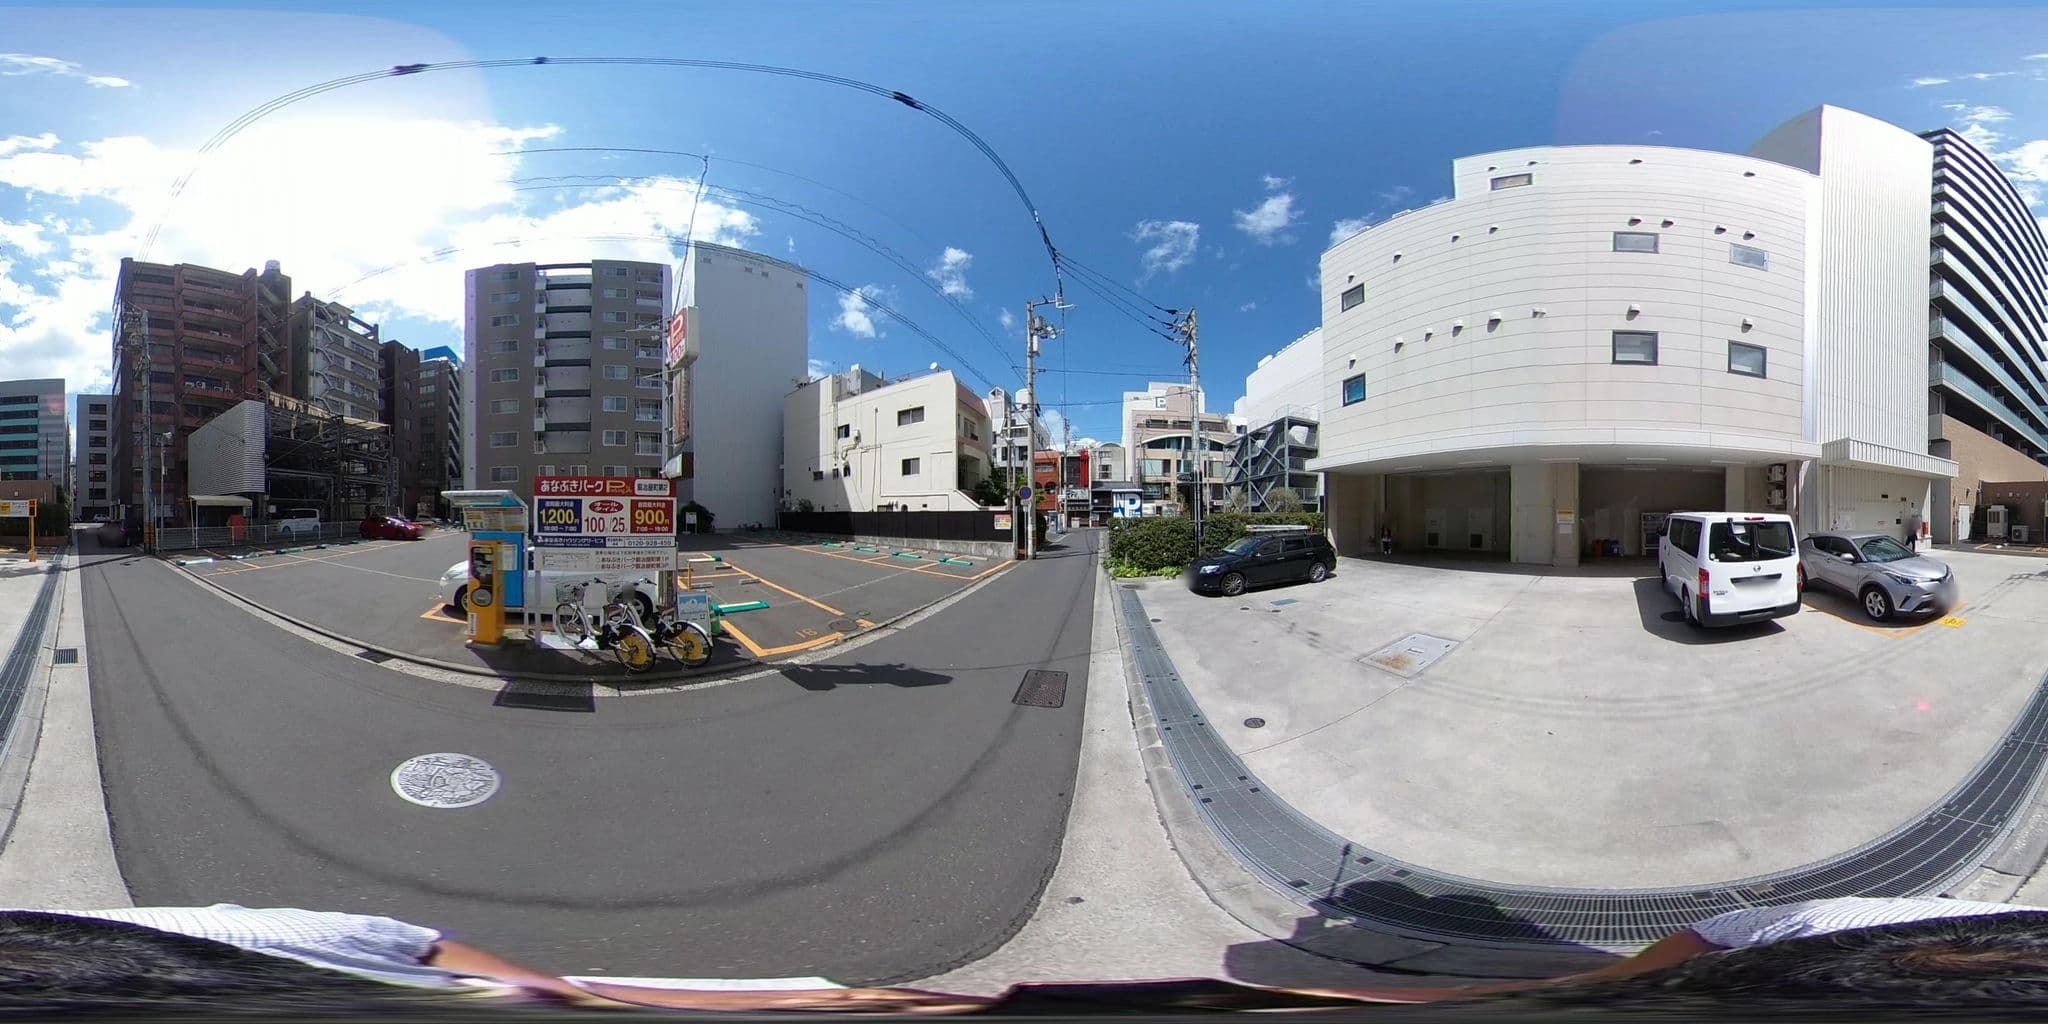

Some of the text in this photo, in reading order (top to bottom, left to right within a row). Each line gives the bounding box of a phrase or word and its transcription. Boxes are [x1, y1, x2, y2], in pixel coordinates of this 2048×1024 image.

[541, 480, 603, 492] あなぶきパーク
